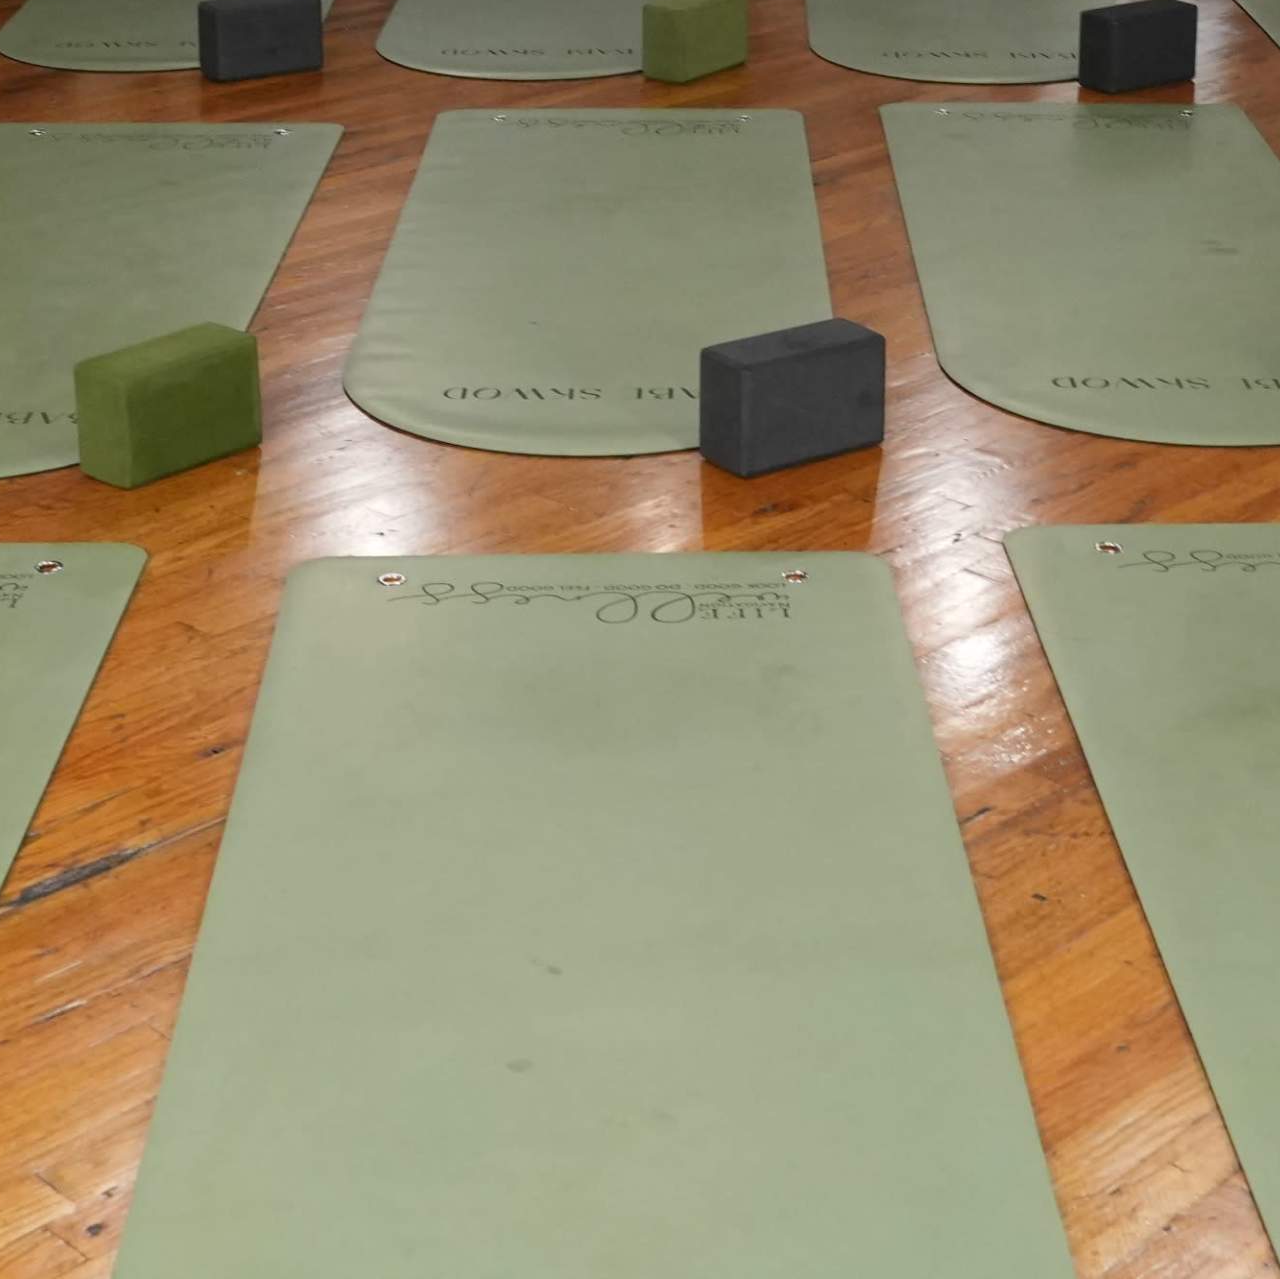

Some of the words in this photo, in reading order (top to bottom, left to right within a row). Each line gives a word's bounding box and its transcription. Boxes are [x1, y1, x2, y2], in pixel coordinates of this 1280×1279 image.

[1052, 378, 1209, 391] SKWOD
[443, 387, 601, 400] SKWOD
[700, 608, 790, 619] LIFE
